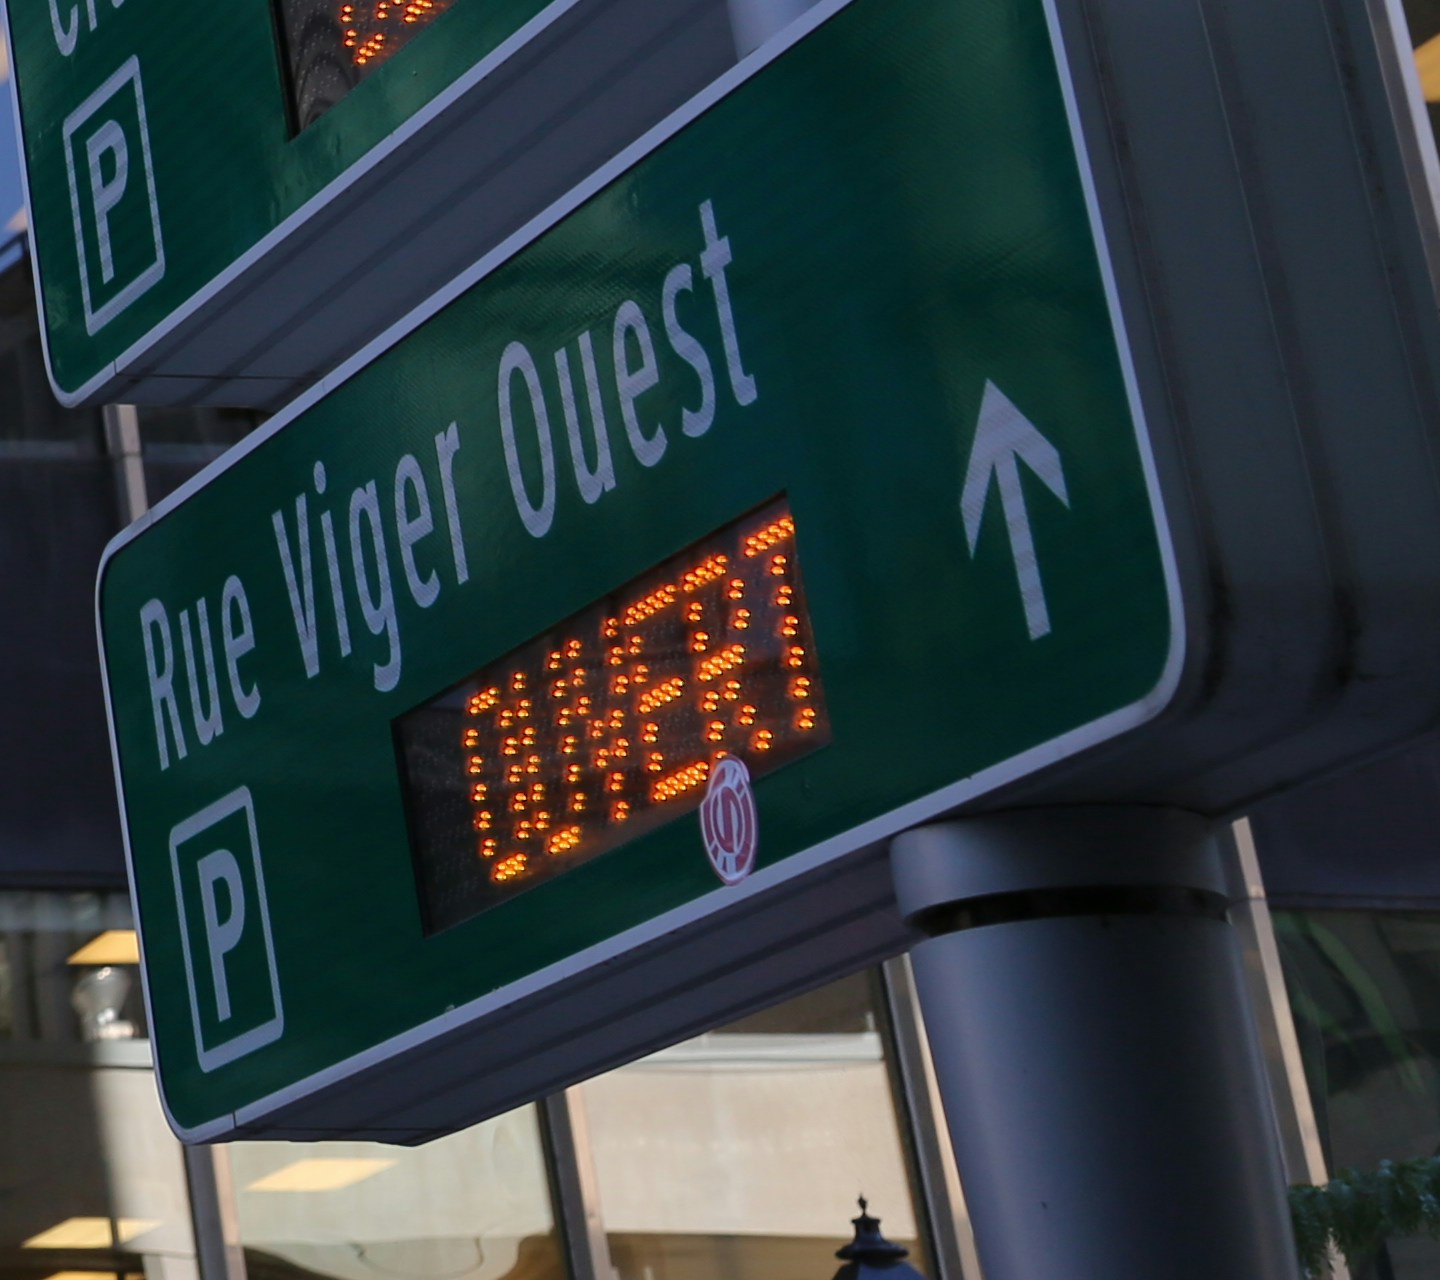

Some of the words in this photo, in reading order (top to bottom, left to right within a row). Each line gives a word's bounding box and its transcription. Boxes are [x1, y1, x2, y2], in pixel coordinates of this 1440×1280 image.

[85, 119, 129, 285] P
[139, 574, 262, 771] Rue
[272, 420, 470, 693] Viger
[497, 198, 758, 539] Ouest
[463, 515, 818, 883] OUVERT
[196, 848, 246, 1022] P
